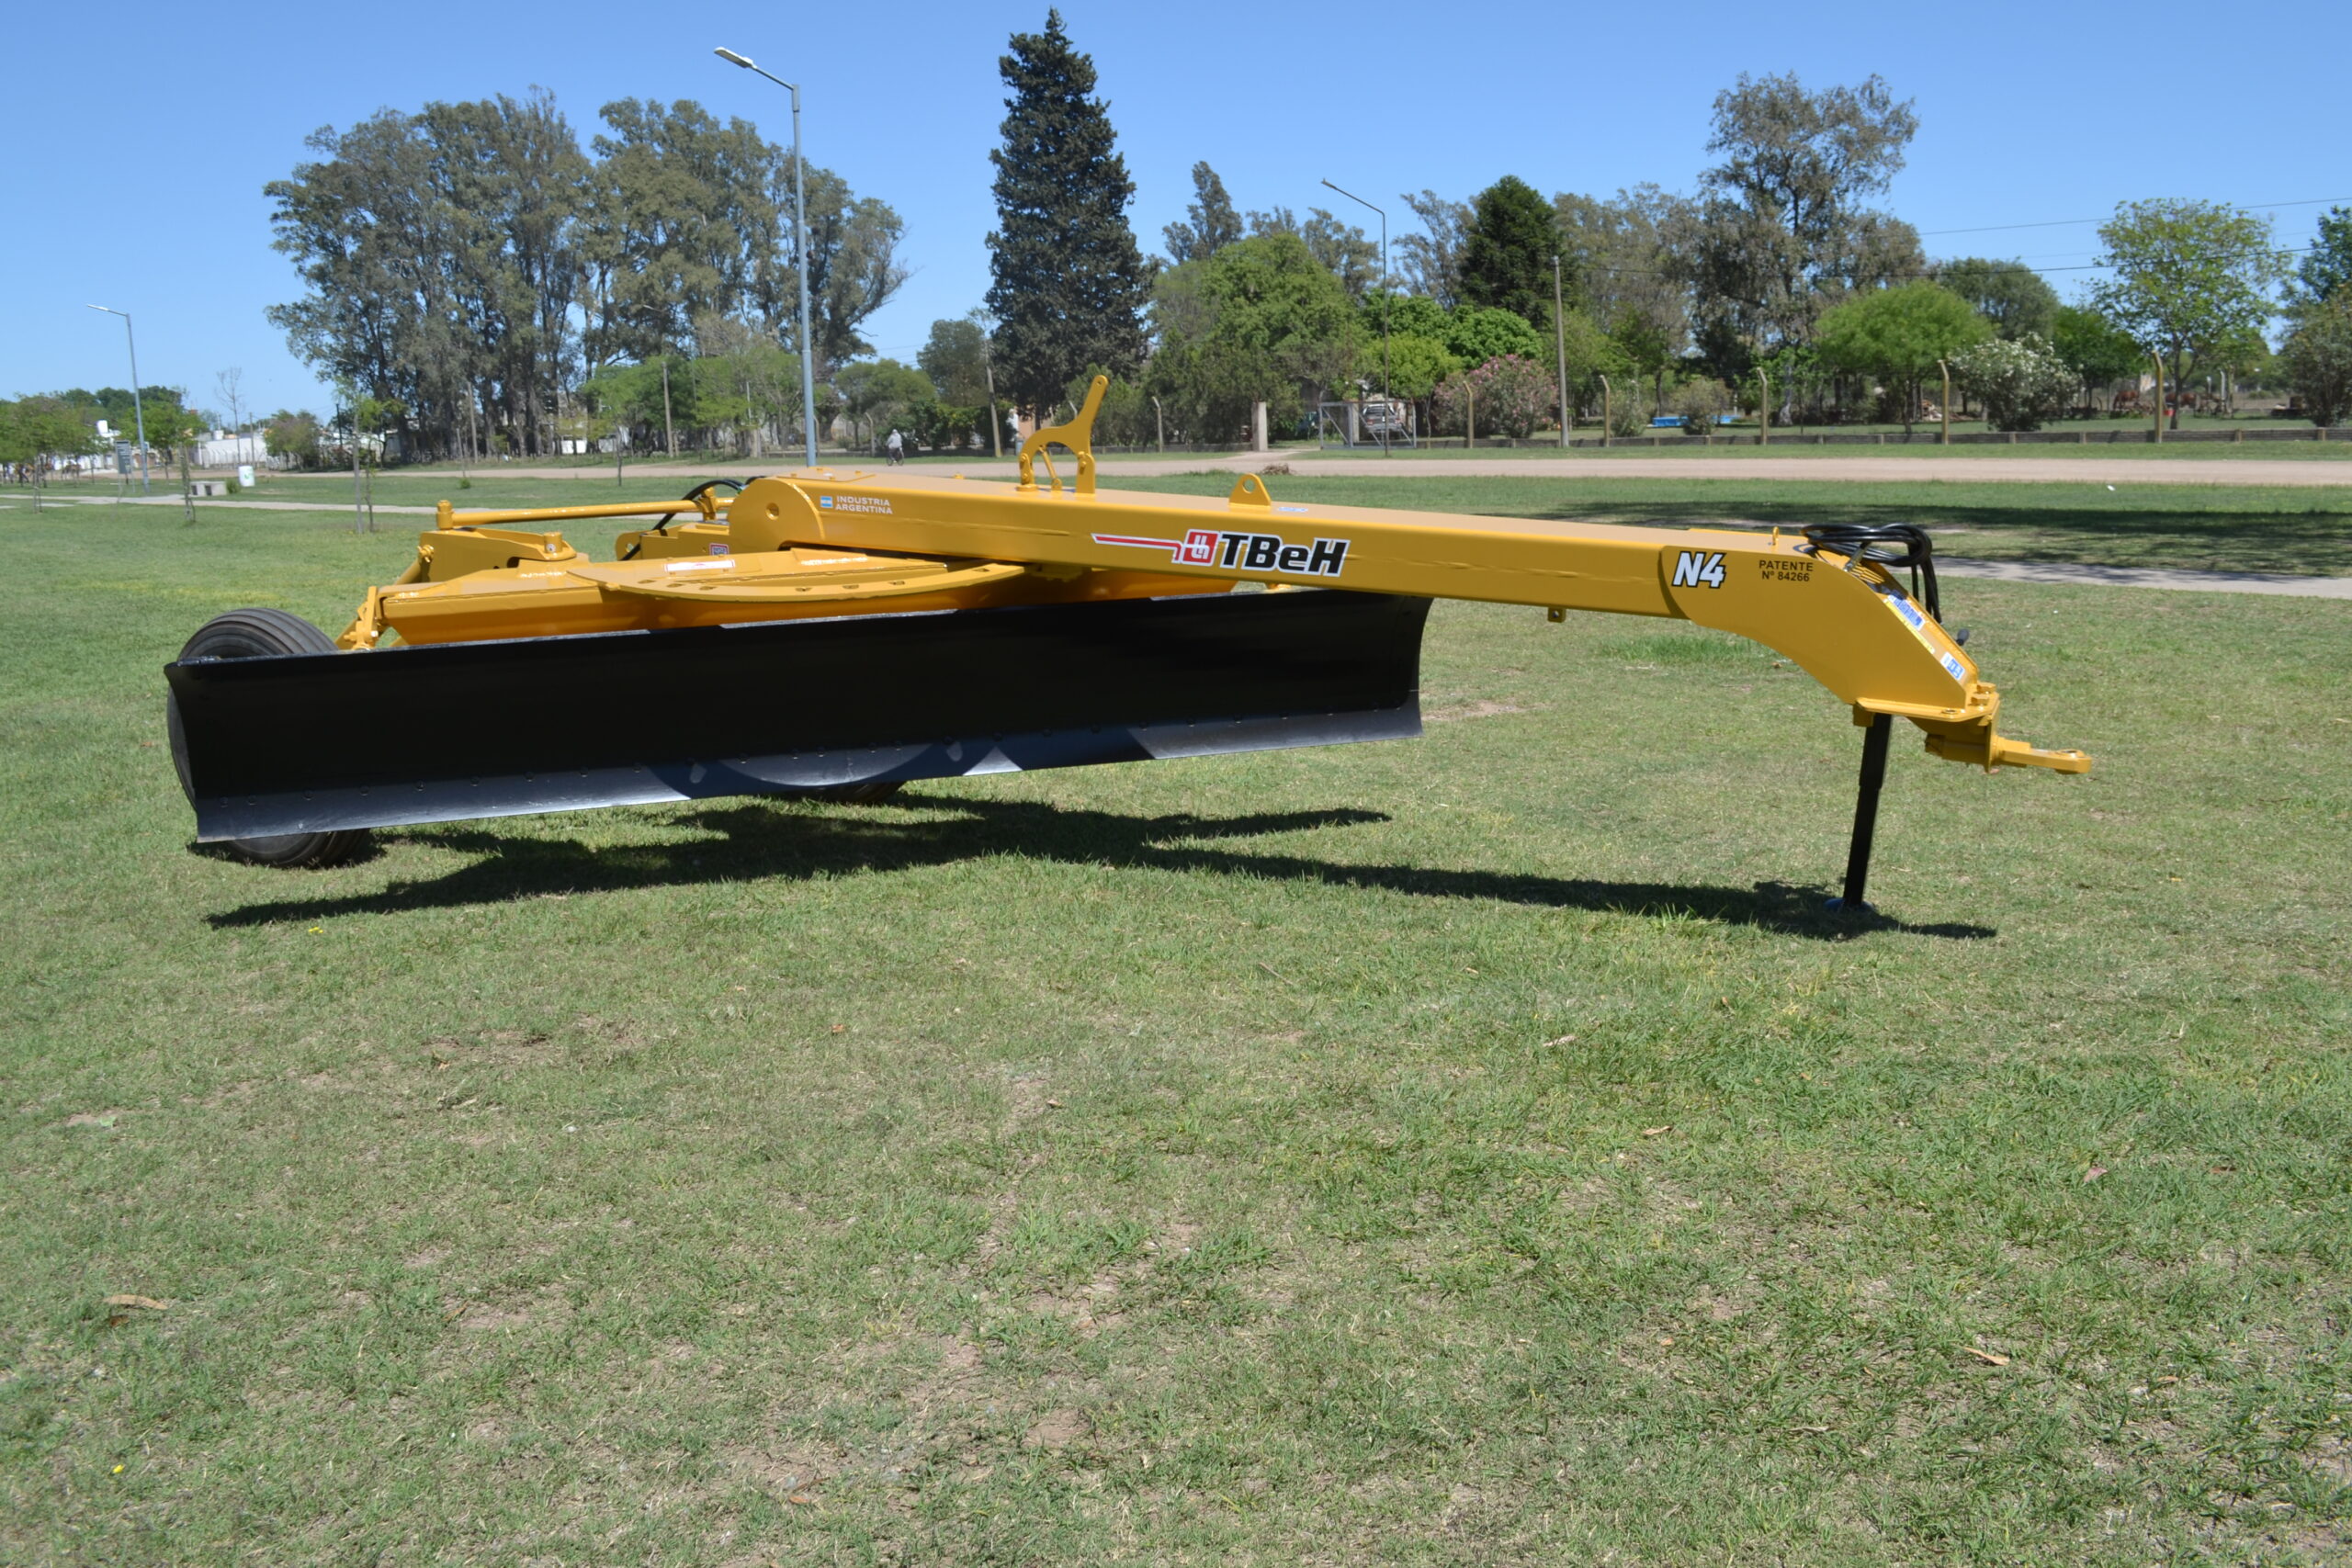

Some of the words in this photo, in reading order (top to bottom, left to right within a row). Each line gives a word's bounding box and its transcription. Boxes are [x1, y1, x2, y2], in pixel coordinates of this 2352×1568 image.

[836, 495, 890, 506] INDUSTRIA
[835, 503, 893, 514] ARGENTINA
[1219, 530, 1351, 577] TBeH
[1671, 550, 1726, 589] N4
[1758, 559, 1814, 571] PATENTE
[1777, 571, 1810, 582] 84266
